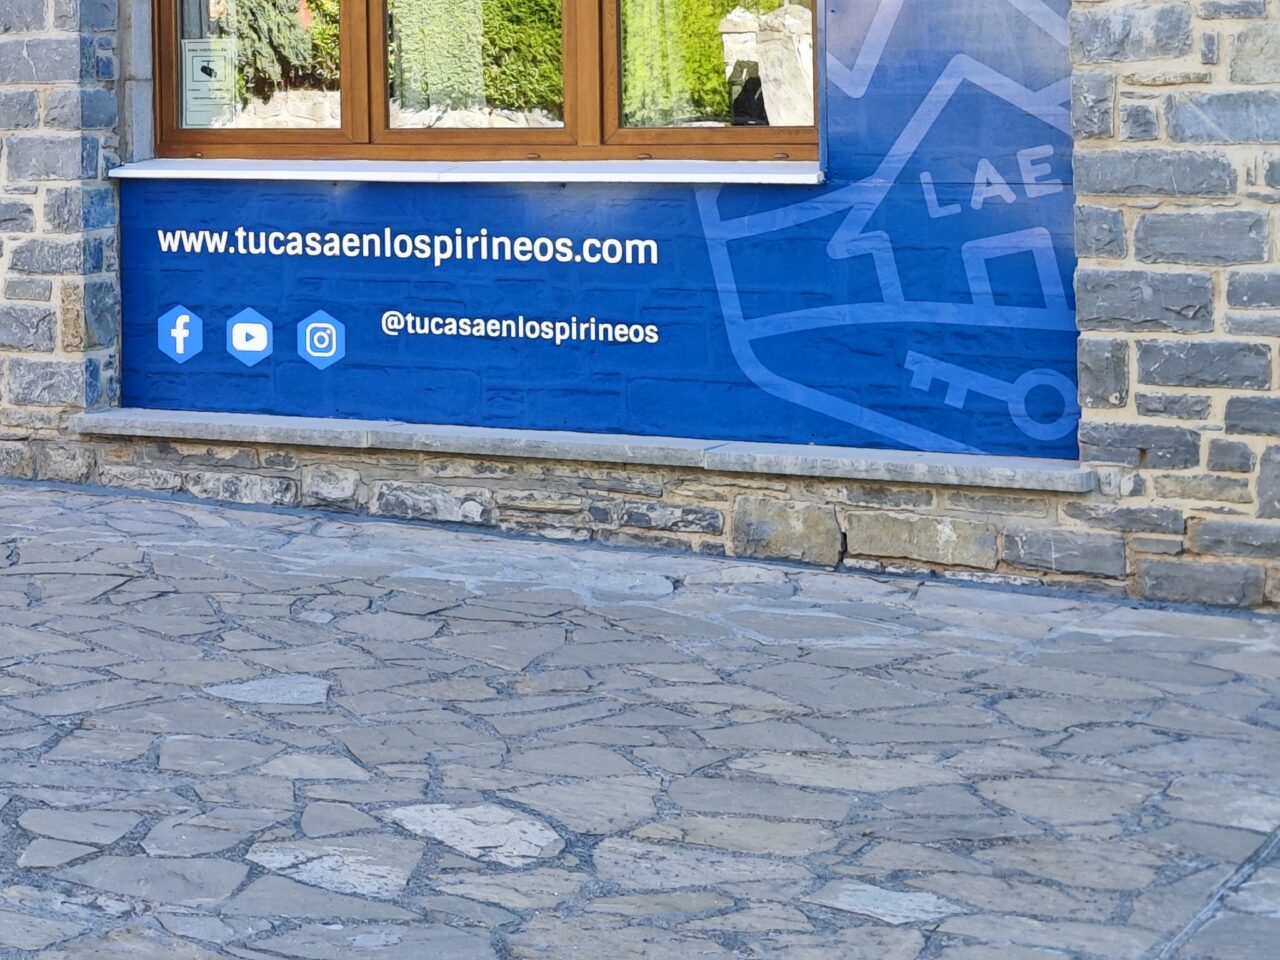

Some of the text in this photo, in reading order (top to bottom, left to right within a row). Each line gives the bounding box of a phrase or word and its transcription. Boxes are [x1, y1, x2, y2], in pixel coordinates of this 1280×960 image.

[920, 144, 1063, 218] LAE
[157, 227, 659, 267] www.tucasaenlospirineos.com
[381, 310, 659, 345] @tucasaenlospirineos
